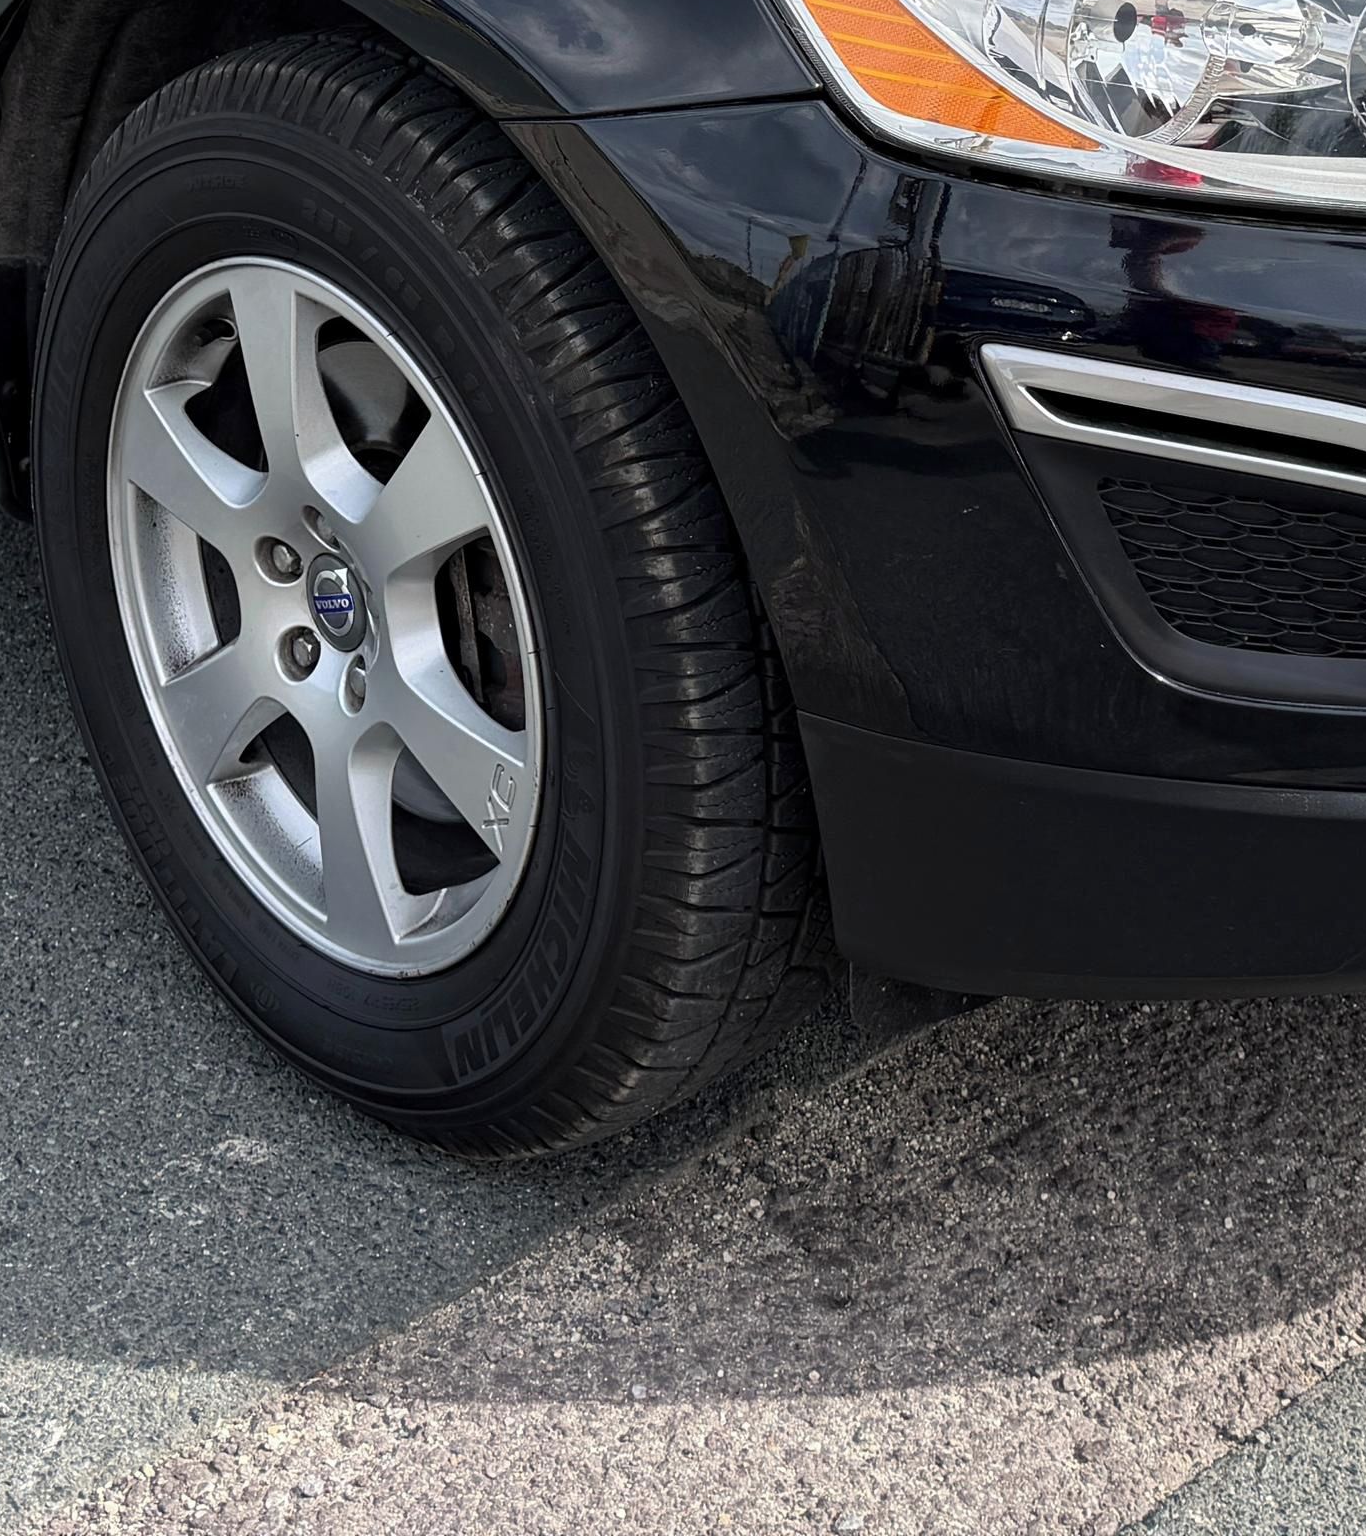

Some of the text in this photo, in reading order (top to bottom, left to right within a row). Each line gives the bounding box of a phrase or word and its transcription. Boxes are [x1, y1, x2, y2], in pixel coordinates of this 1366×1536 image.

[315, 598, 349, 609] VOLVO
[481, 763, 517, 853] XC
[452, 822, 595, 1079] MICHELIN
